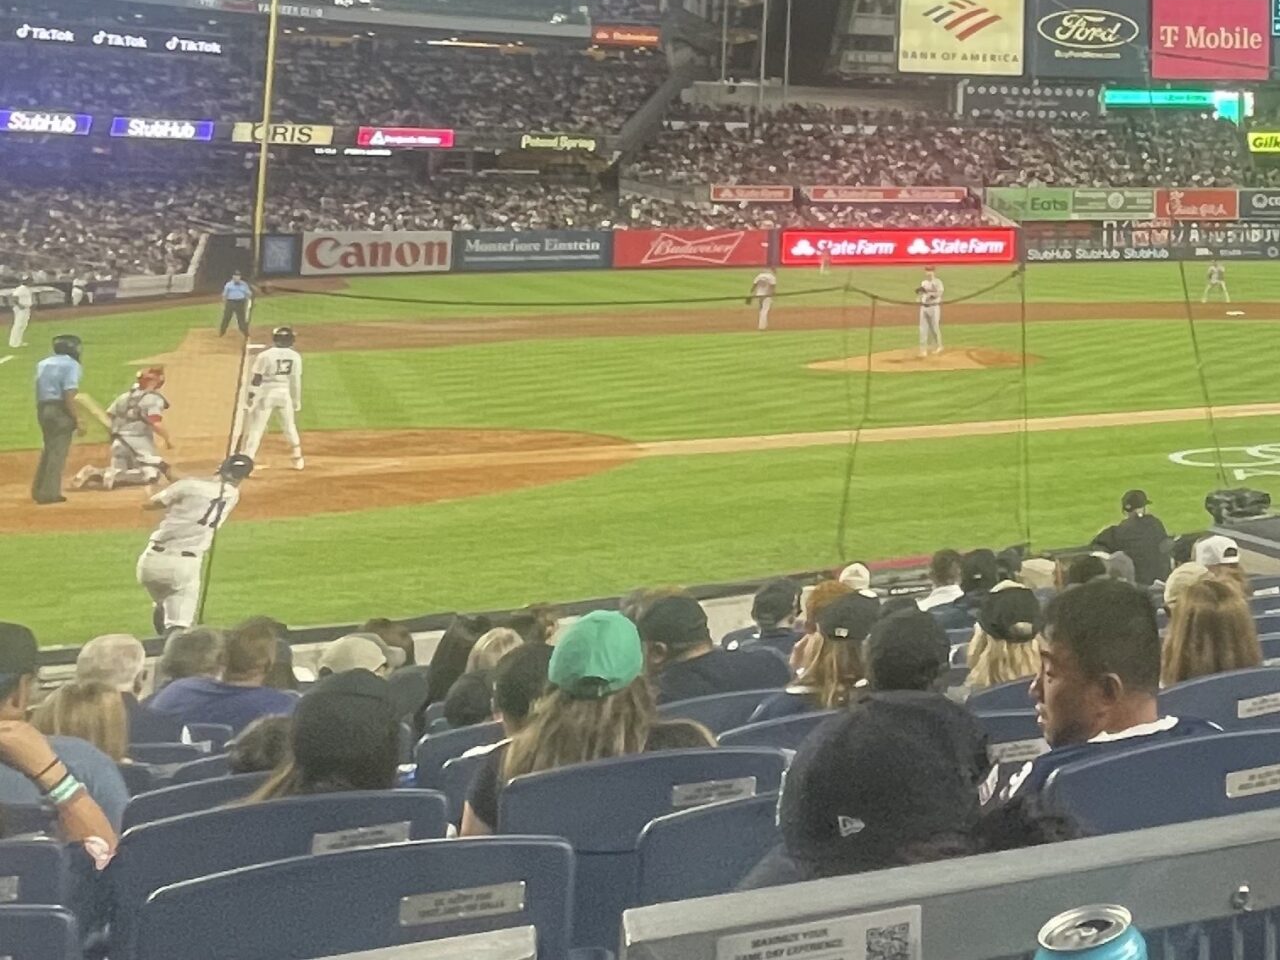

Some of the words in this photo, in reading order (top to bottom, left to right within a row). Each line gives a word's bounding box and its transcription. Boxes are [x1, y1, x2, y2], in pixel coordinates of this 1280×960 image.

[33, 26, 75, 42] TikTok
[1055, 14, 1121, 43] Ford
[108, 33, 148, 49] TikTok
[1160, 25, 1180, 48] T
[1185, 25, 1263, 49] Mobile
[180, 40, 222, 54] TikTok
[903, 50, 937, 60] BANK
[941, 51, 957, 61] OF
[960, 52, 1020, 63] AMERICA
[8, 112, 77, 134] StubHub
[128, 118, 195, 138] StubHub
[251, 124, 313, 144] ORIS
[521, 134, 558, 150] Poland
[1031, 197, 1069, 211] Eats
[305, 236, 448, 269] Canon
[465, 237, 542, 253] Montefiore
[544, 237, 601, 253] Einstein
[654, 241, 735, 257] Budweiser
[1075, 247, 1120, 259] StubHub
[1124, 246, 1169, 259] StubHub
[1028, 248, 1072, 260] StubHub
[275, 359, 293, 375] 13
[198, 497, 227, 529] 11
